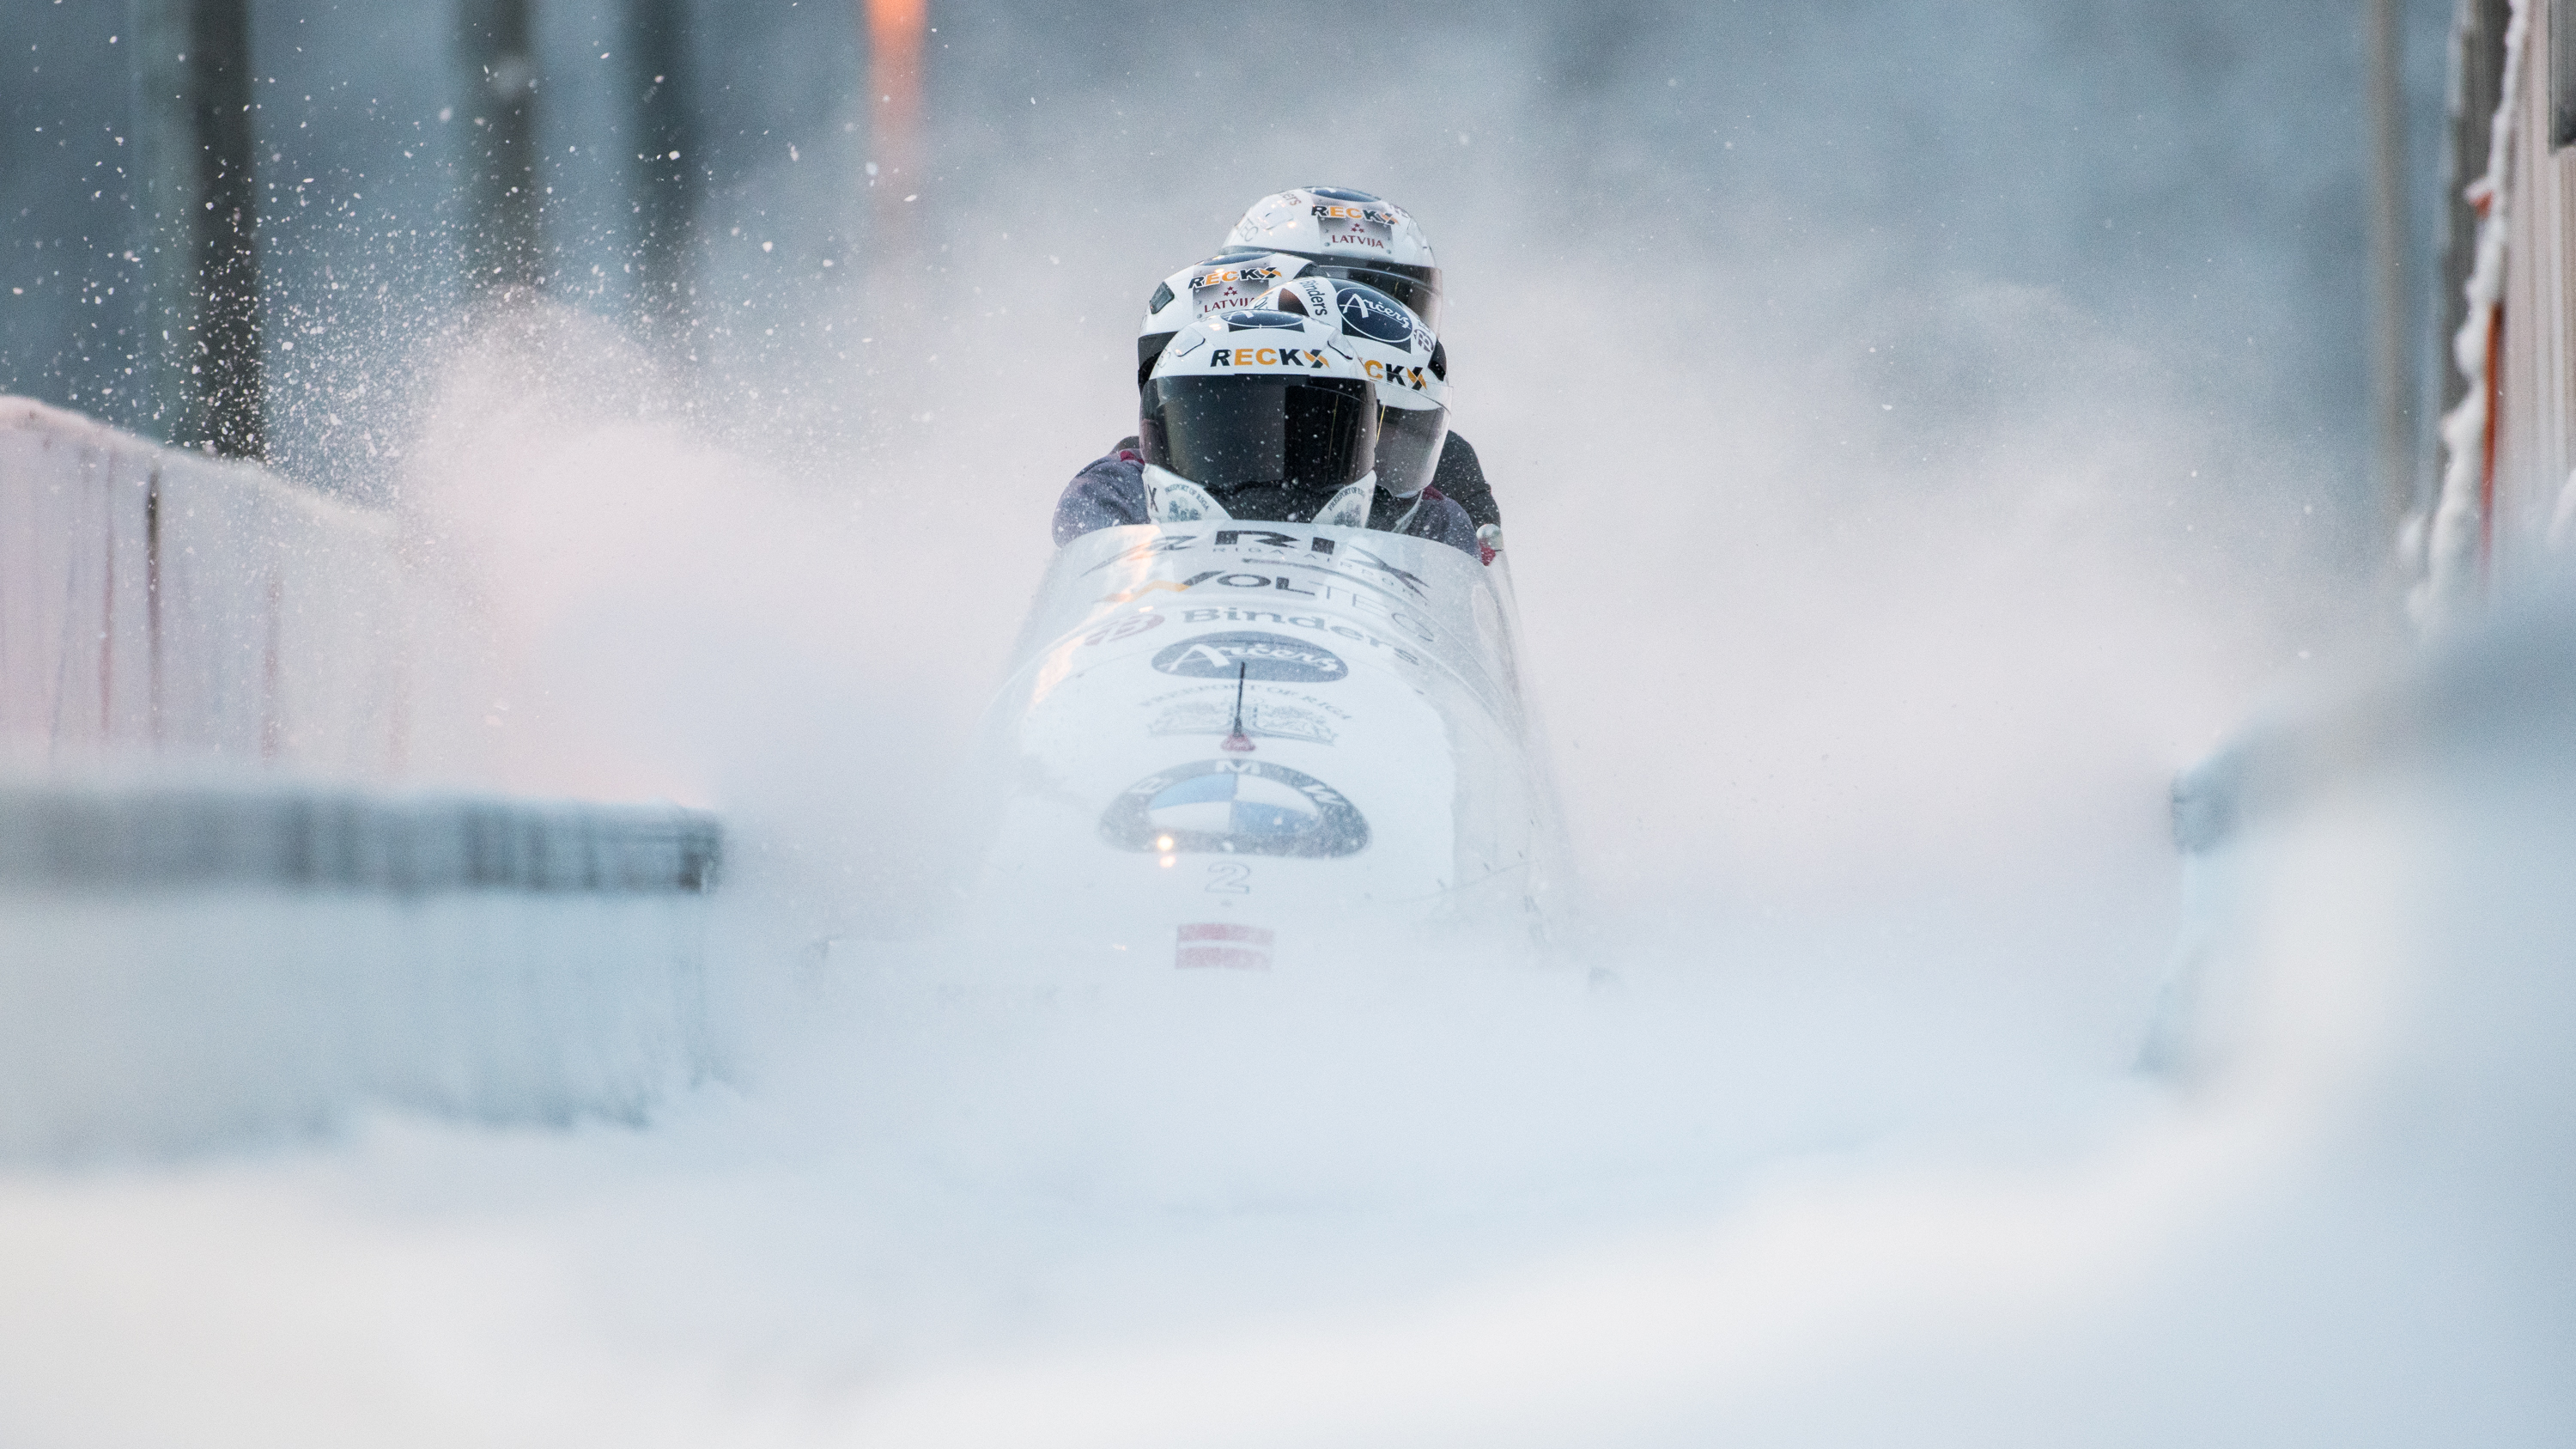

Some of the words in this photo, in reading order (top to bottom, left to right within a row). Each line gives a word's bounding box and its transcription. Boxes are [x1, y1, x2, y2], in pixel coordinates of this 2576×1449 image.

[1332, 234, 1384, 248] LATVIJA
[1299, 279, 1327, 316] Binders
[1214, 530, 1431, 600] RIX
[1182, 606, 1419, 667] Binders
[1128, 760, 1349, 807] BMW
[1204, 861, 1252, 895] 2
